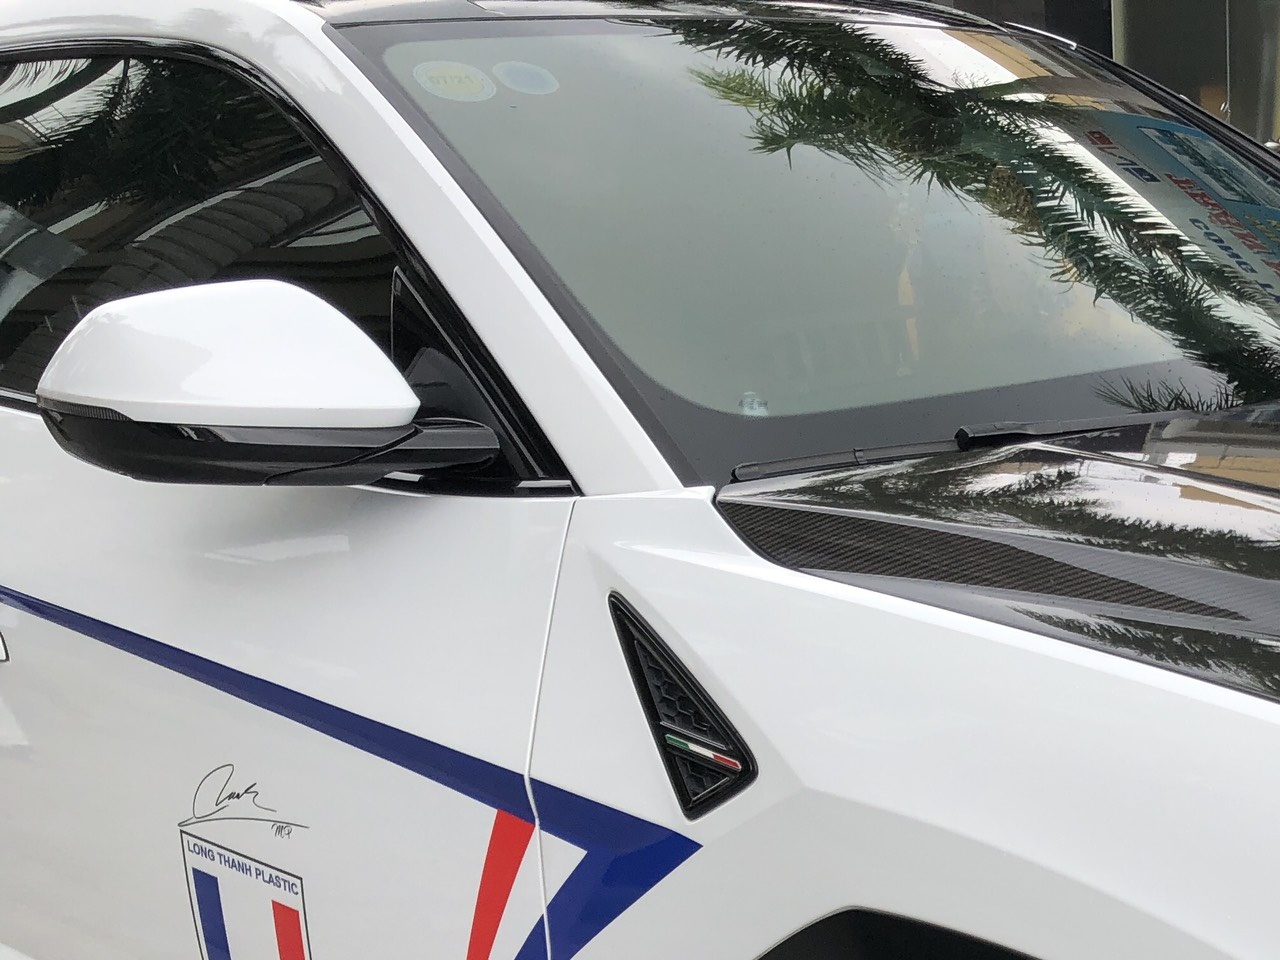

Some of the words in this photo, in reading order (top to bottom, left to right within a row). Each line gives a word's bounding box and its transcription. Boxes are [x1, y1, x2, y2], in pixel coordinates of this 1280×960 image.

[187, 840, 215, 861] LONG
[217, 852, 252, 877] THANH
[255, 868, 299, 896] PLASTIC
